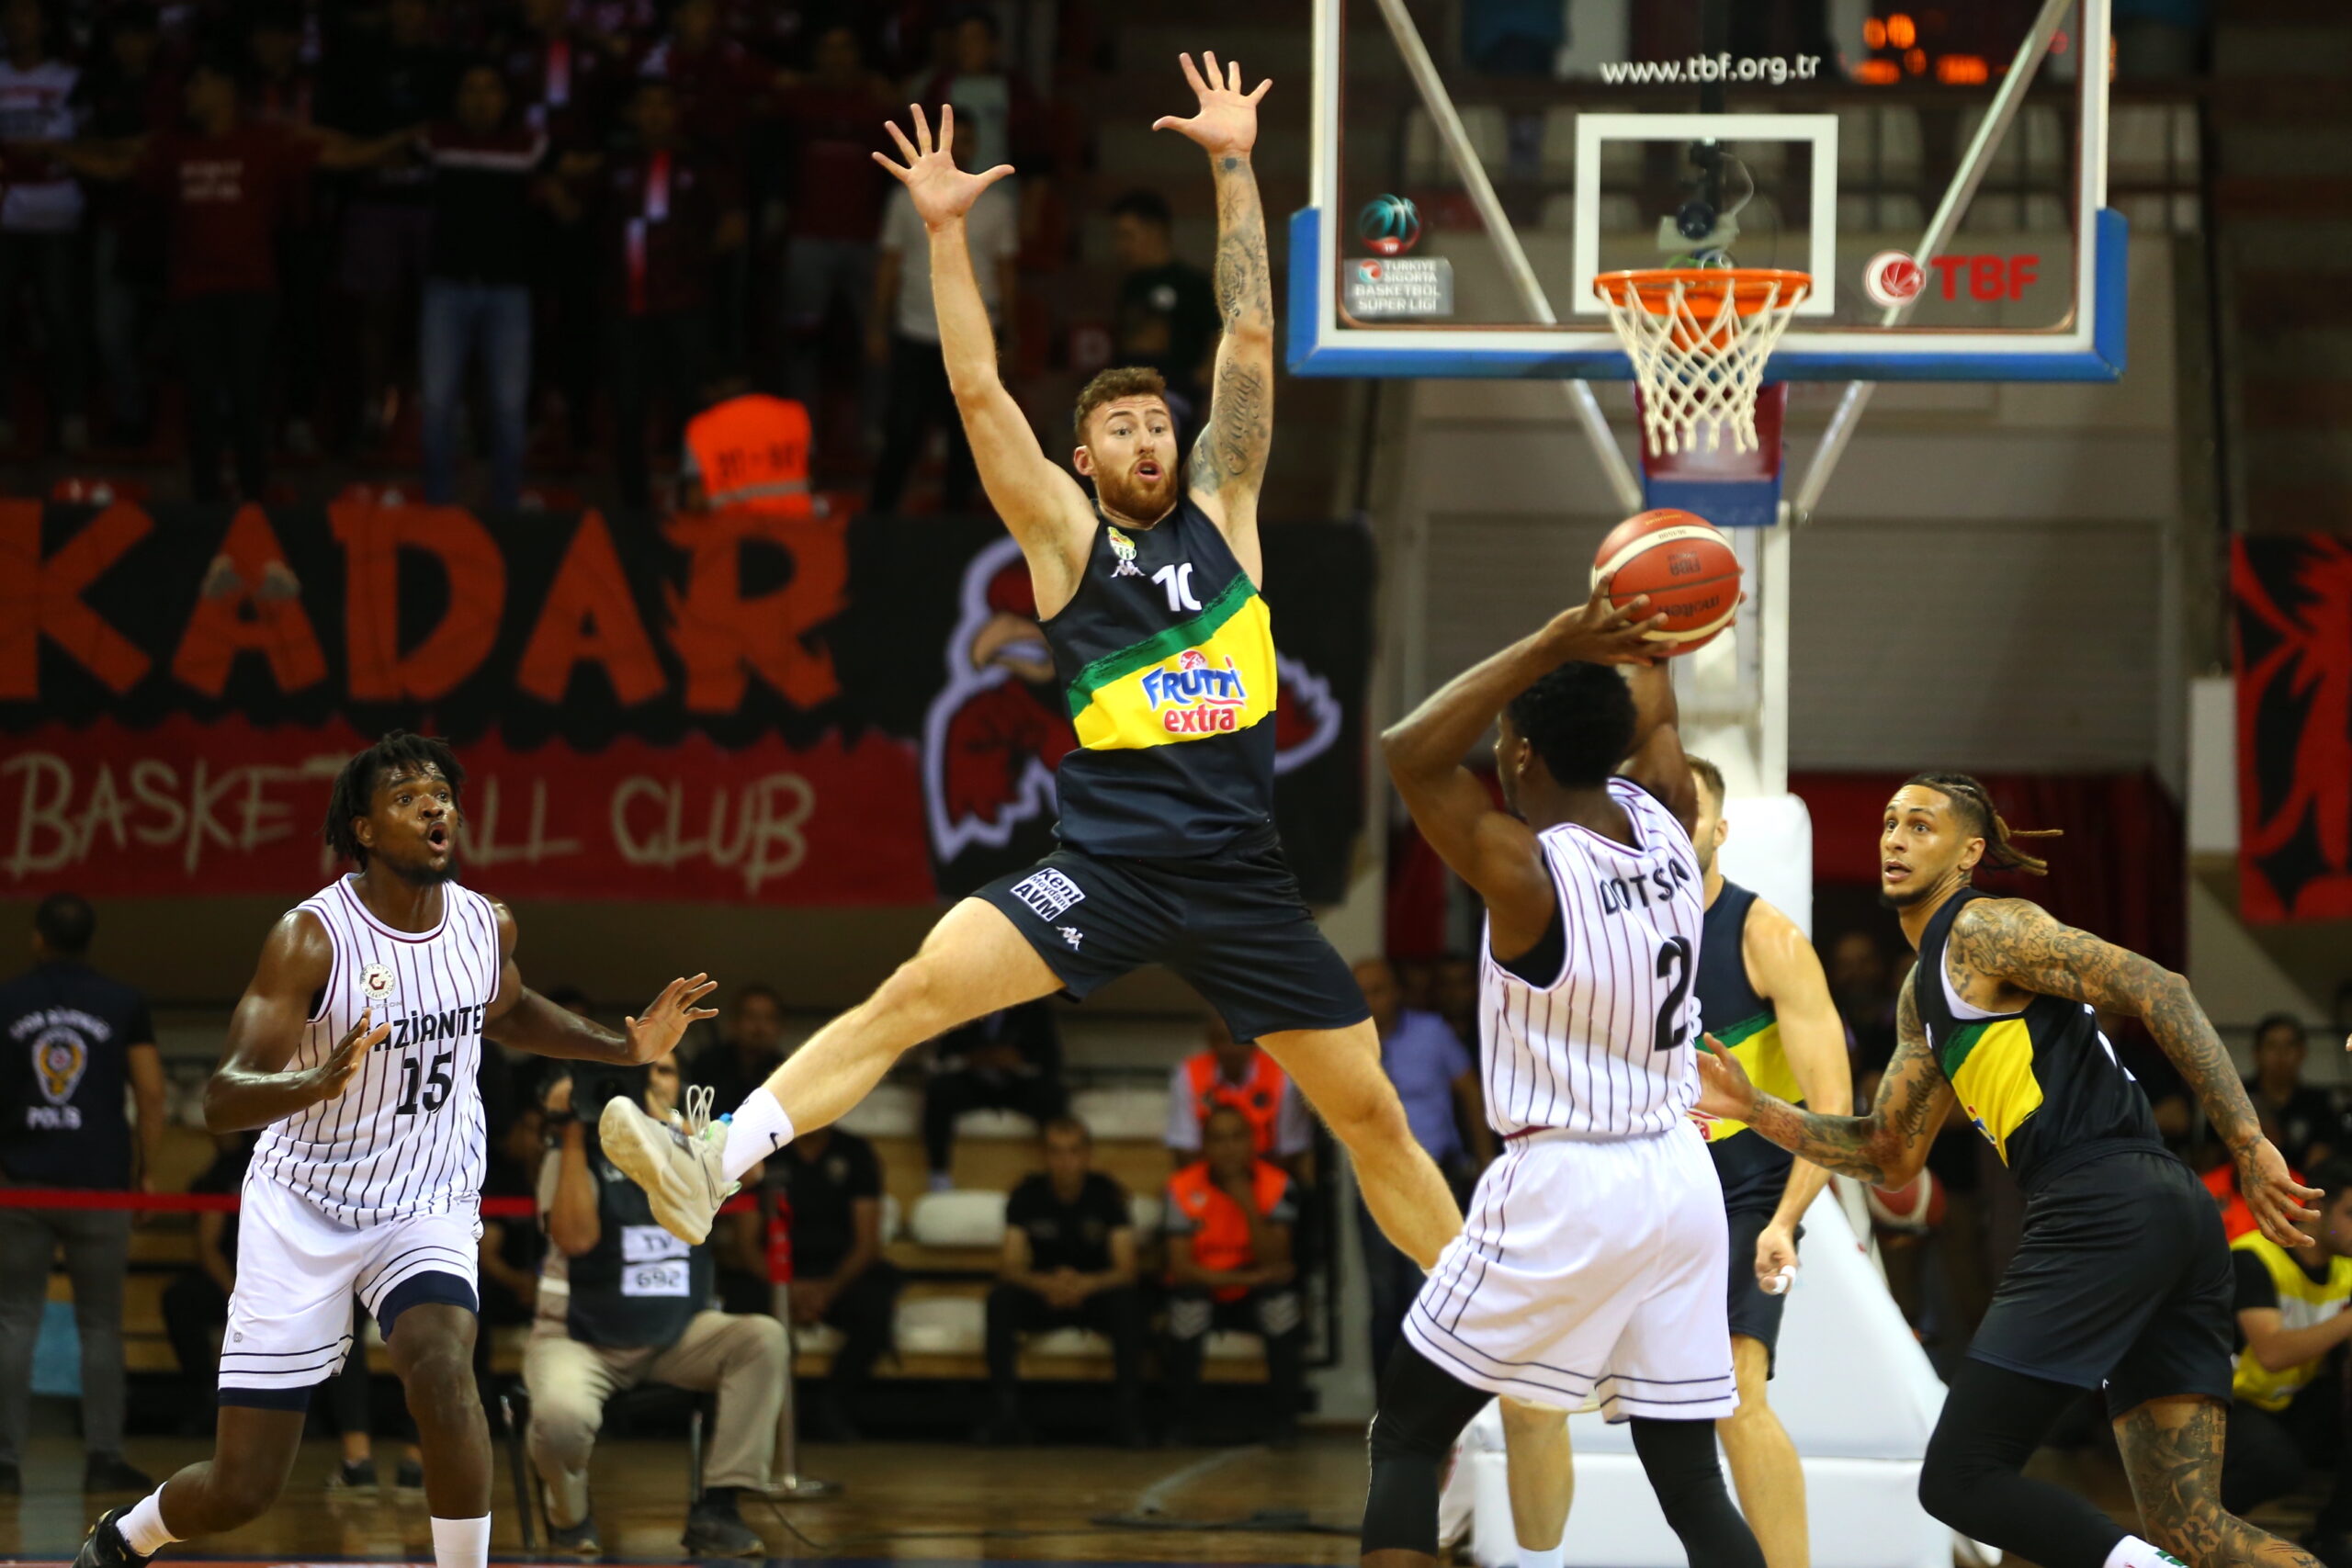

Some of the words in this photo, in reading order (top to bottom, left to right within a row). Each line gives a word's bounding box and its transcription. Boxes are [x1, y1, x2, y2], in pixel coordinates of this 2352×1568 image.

[1599, 51, 1821, 85] www.tbf.org.tr
[1930, 254, 2041, 301] TBF
[1164, 704, 1236, 733] extra
[609, 773, 817, 897] CLUB
[1013, 883, 1061, 919] AVM
[1038, 868, 1082, 904] Kent
[1655, 935, 1692, 1051] 2
[395, 1050, 453, 1115] 15
